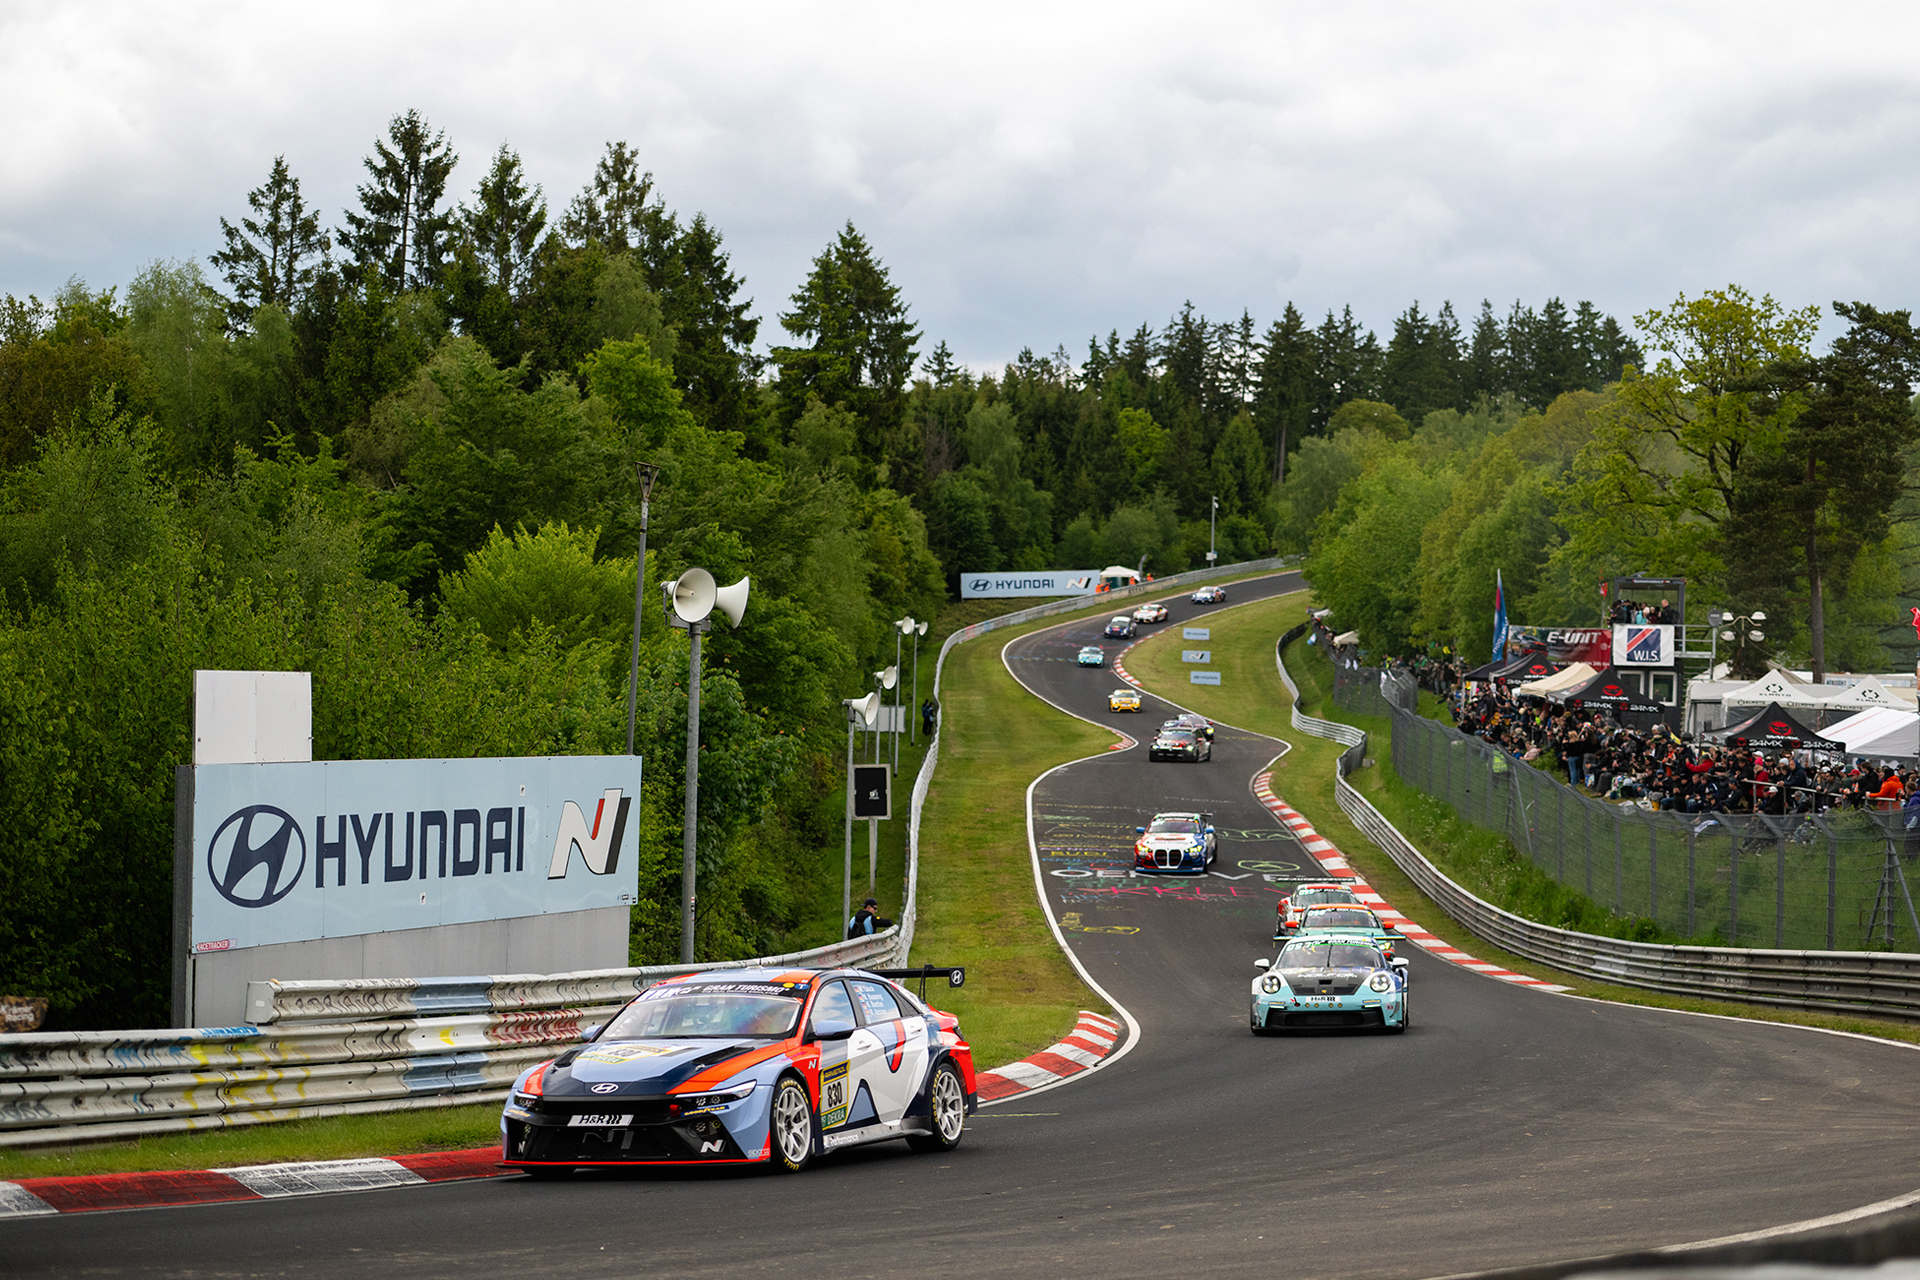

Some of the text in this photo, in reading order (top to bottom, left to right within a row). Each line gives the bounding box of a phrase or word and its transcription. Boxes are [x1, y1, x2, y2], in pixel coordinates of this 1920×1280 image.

[995, 579, 1055, 590] HYUNDAI
[1748, 739, 1837, 750] 24MX 24MX
[315, 806, 526, 889] HYUNDAI
[703, 984, 734, 992] GRAN
[735, 984, 784, 993] TURISMO
[808, 1059, 817, 1069] N
[827, 1081, 843, 1108] 830
[827, 1108, 846, 1125] DEKRA
